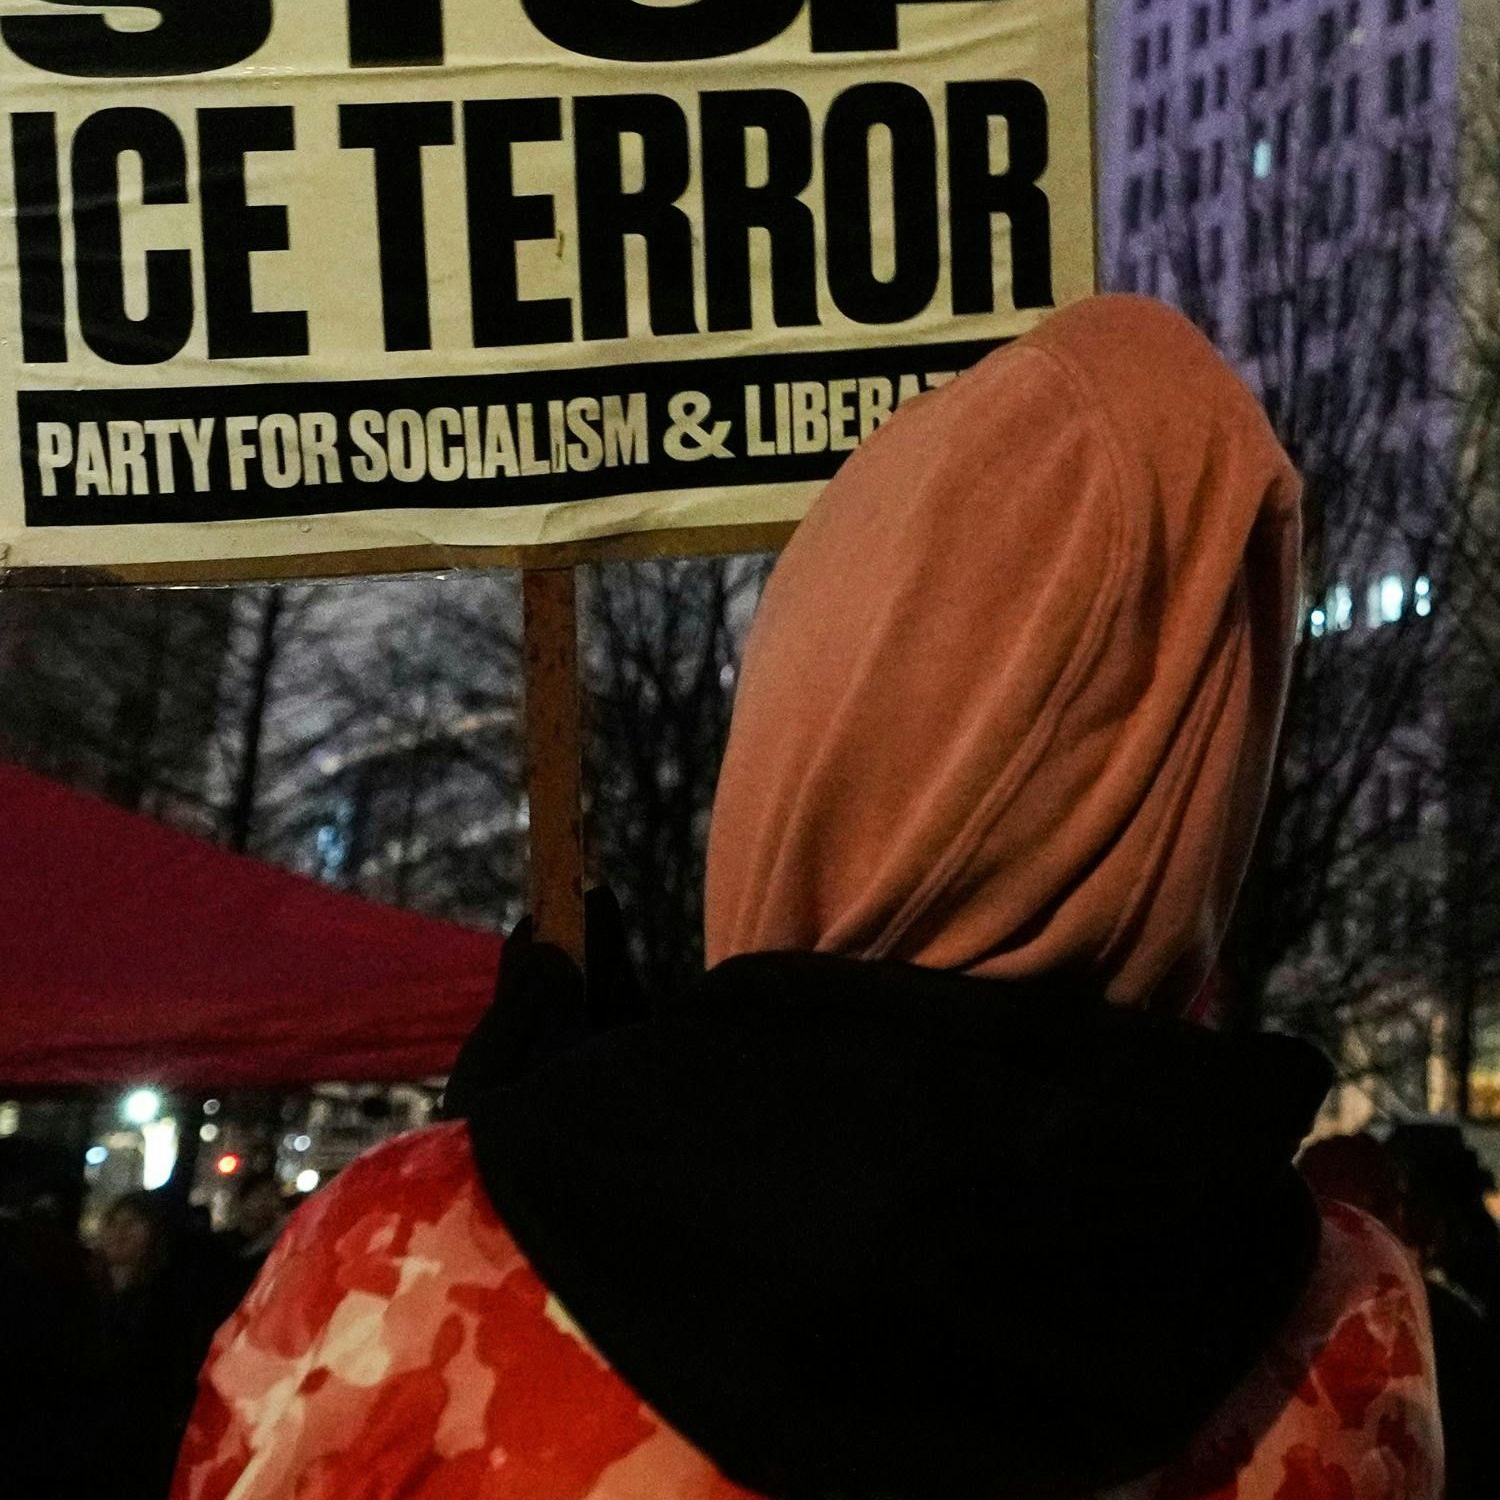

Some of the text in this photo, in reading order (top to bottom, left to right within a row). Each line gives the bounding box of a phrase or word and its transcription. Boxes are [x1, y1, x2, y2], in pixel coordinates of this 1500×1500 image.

[12, 78, 1054, 366] ICE TERROR
[37, 417, 215, 497] PARTY
[225, 411, 343, 489] FOR
[350, 392, 649, 483] SOCIALISM
[663, 390, 735, 462] &
